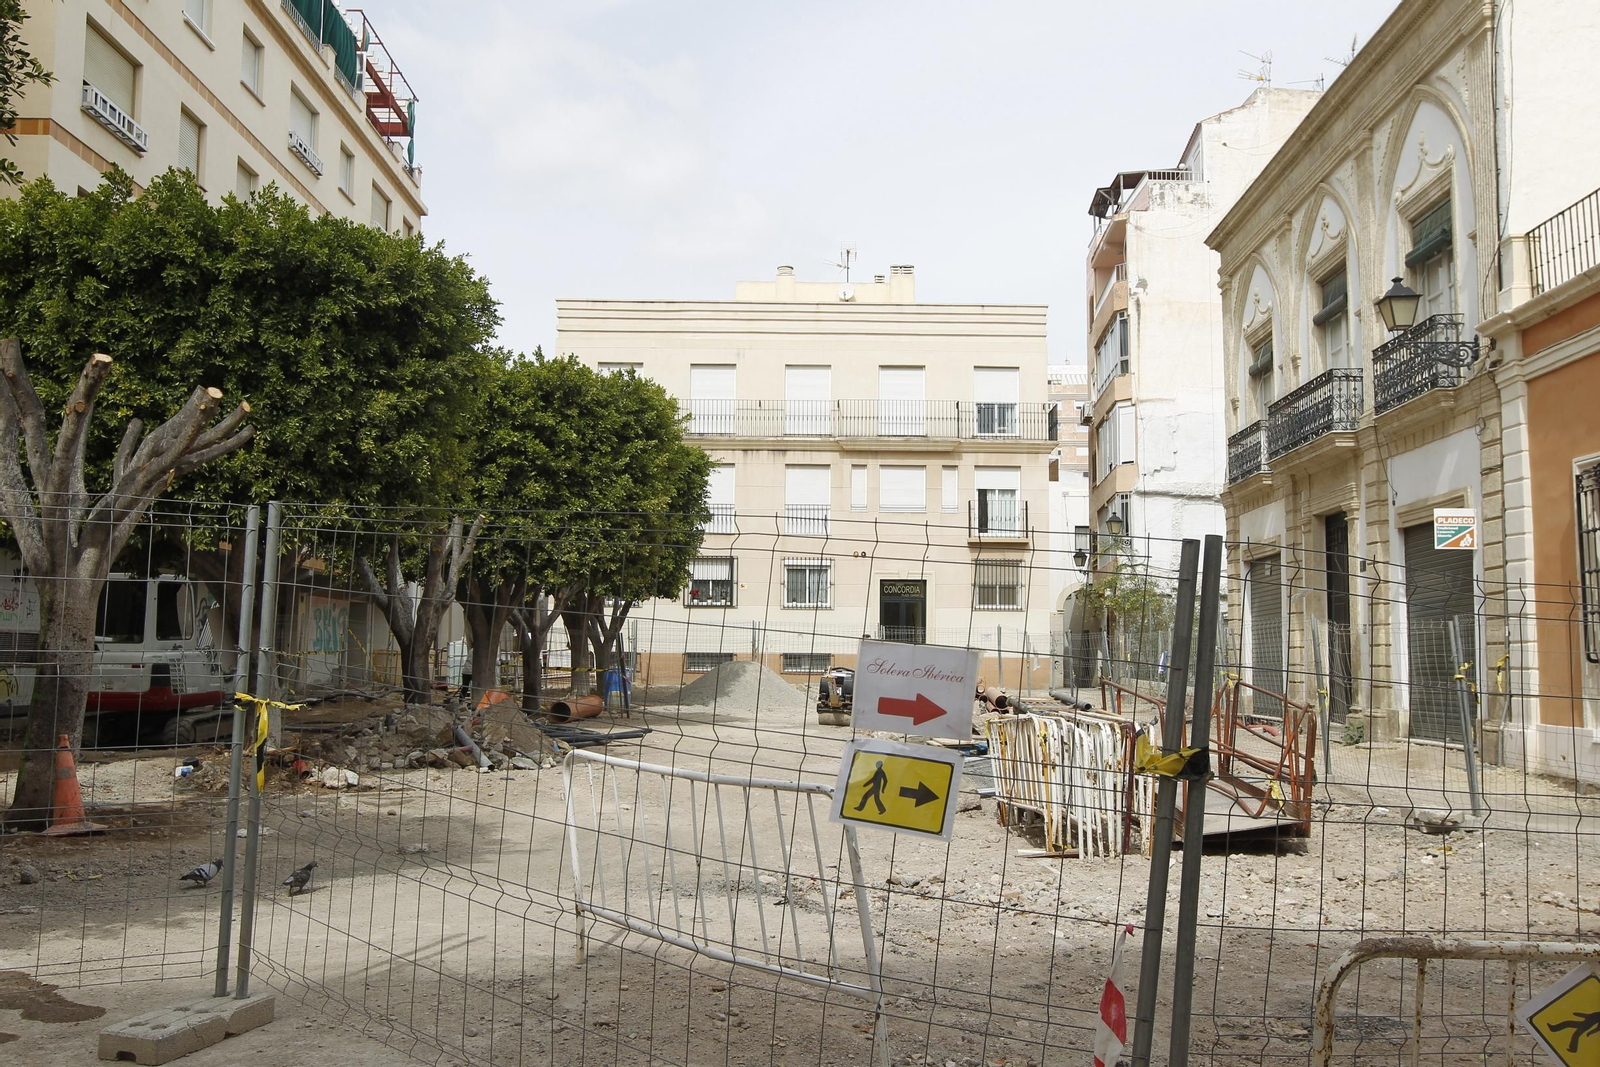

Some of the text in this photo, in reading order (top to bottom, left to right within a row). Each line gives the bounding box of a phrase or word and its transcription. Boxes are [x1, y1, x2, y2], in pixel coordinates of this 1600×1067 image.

[883, 585, 921, 594] CONCORDIA
[866, 658, 965, 683] Solera Ibérica
